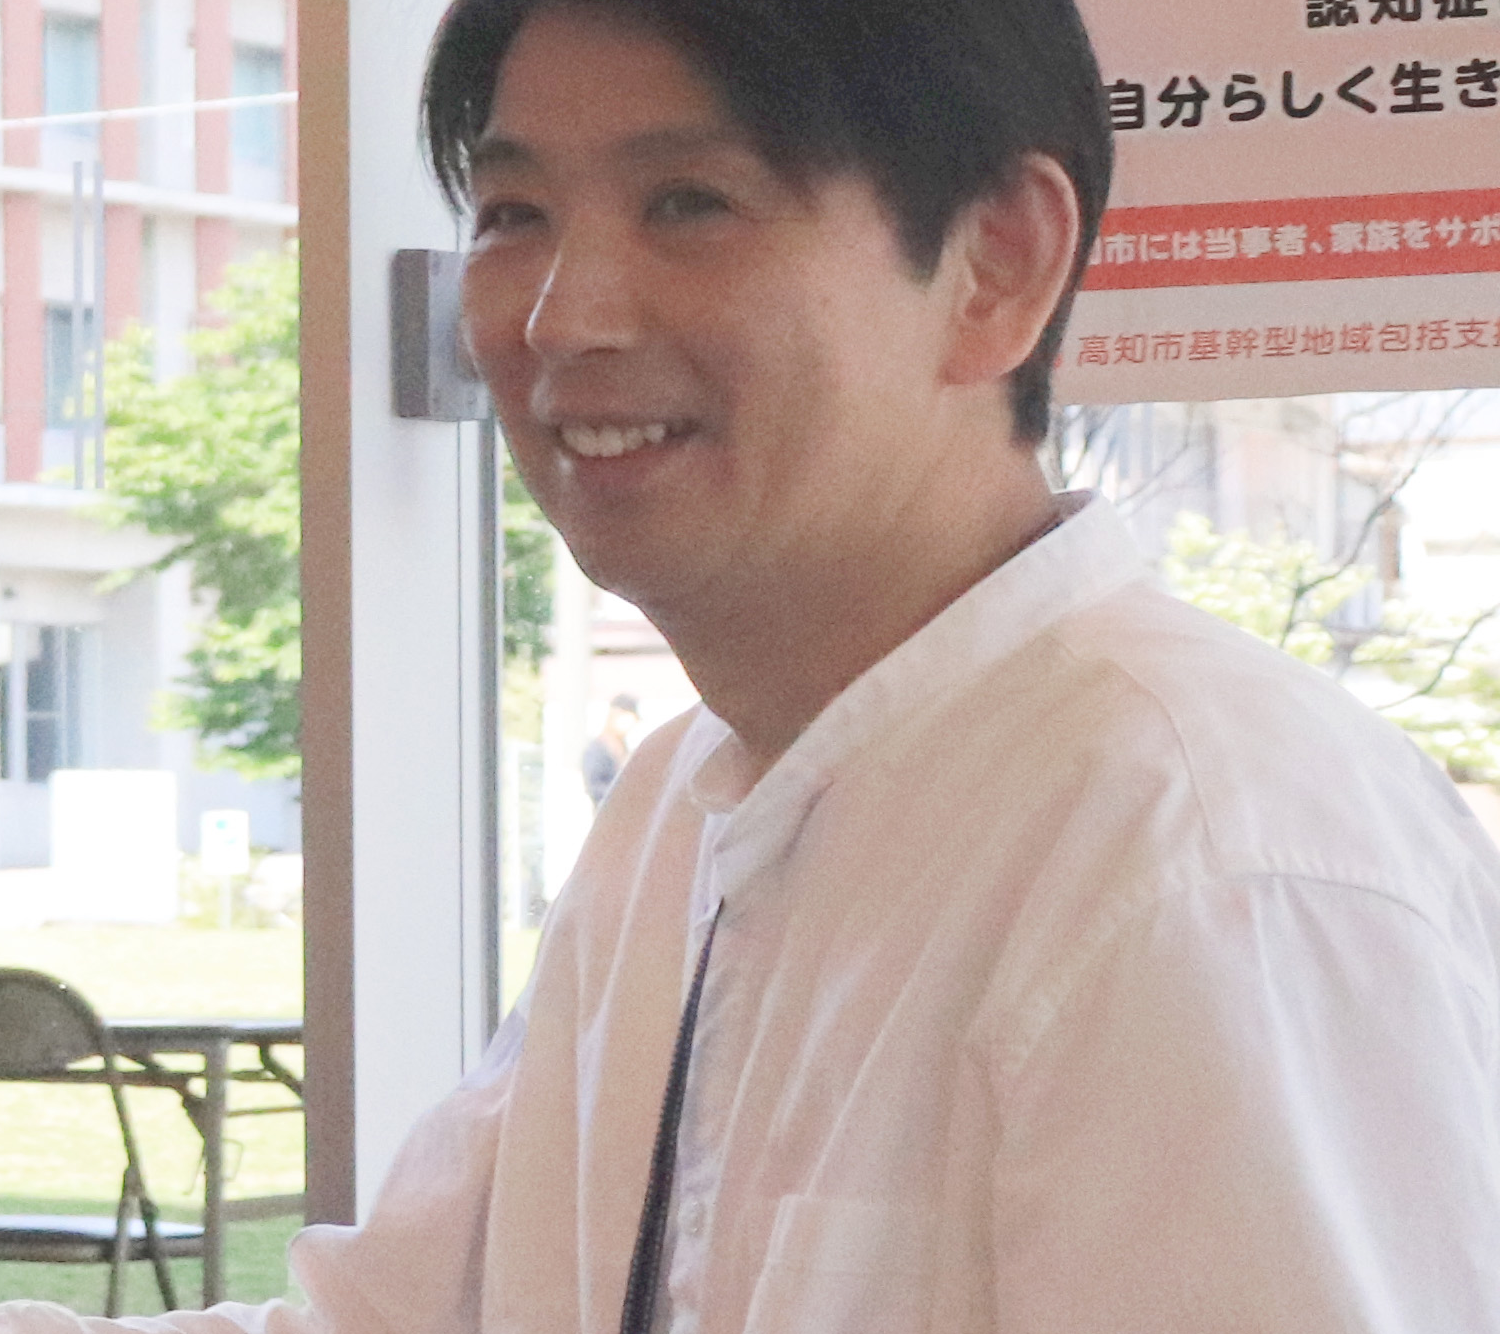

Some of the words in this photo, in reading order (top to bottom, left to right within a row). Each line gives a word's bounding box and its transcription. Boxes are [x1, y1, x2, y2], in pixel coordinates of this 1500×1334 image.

[1103, 58, 1500, 130] 自分らしく生き
[1077, 317, 1500, 367] 高知市基幹型地域包括支
